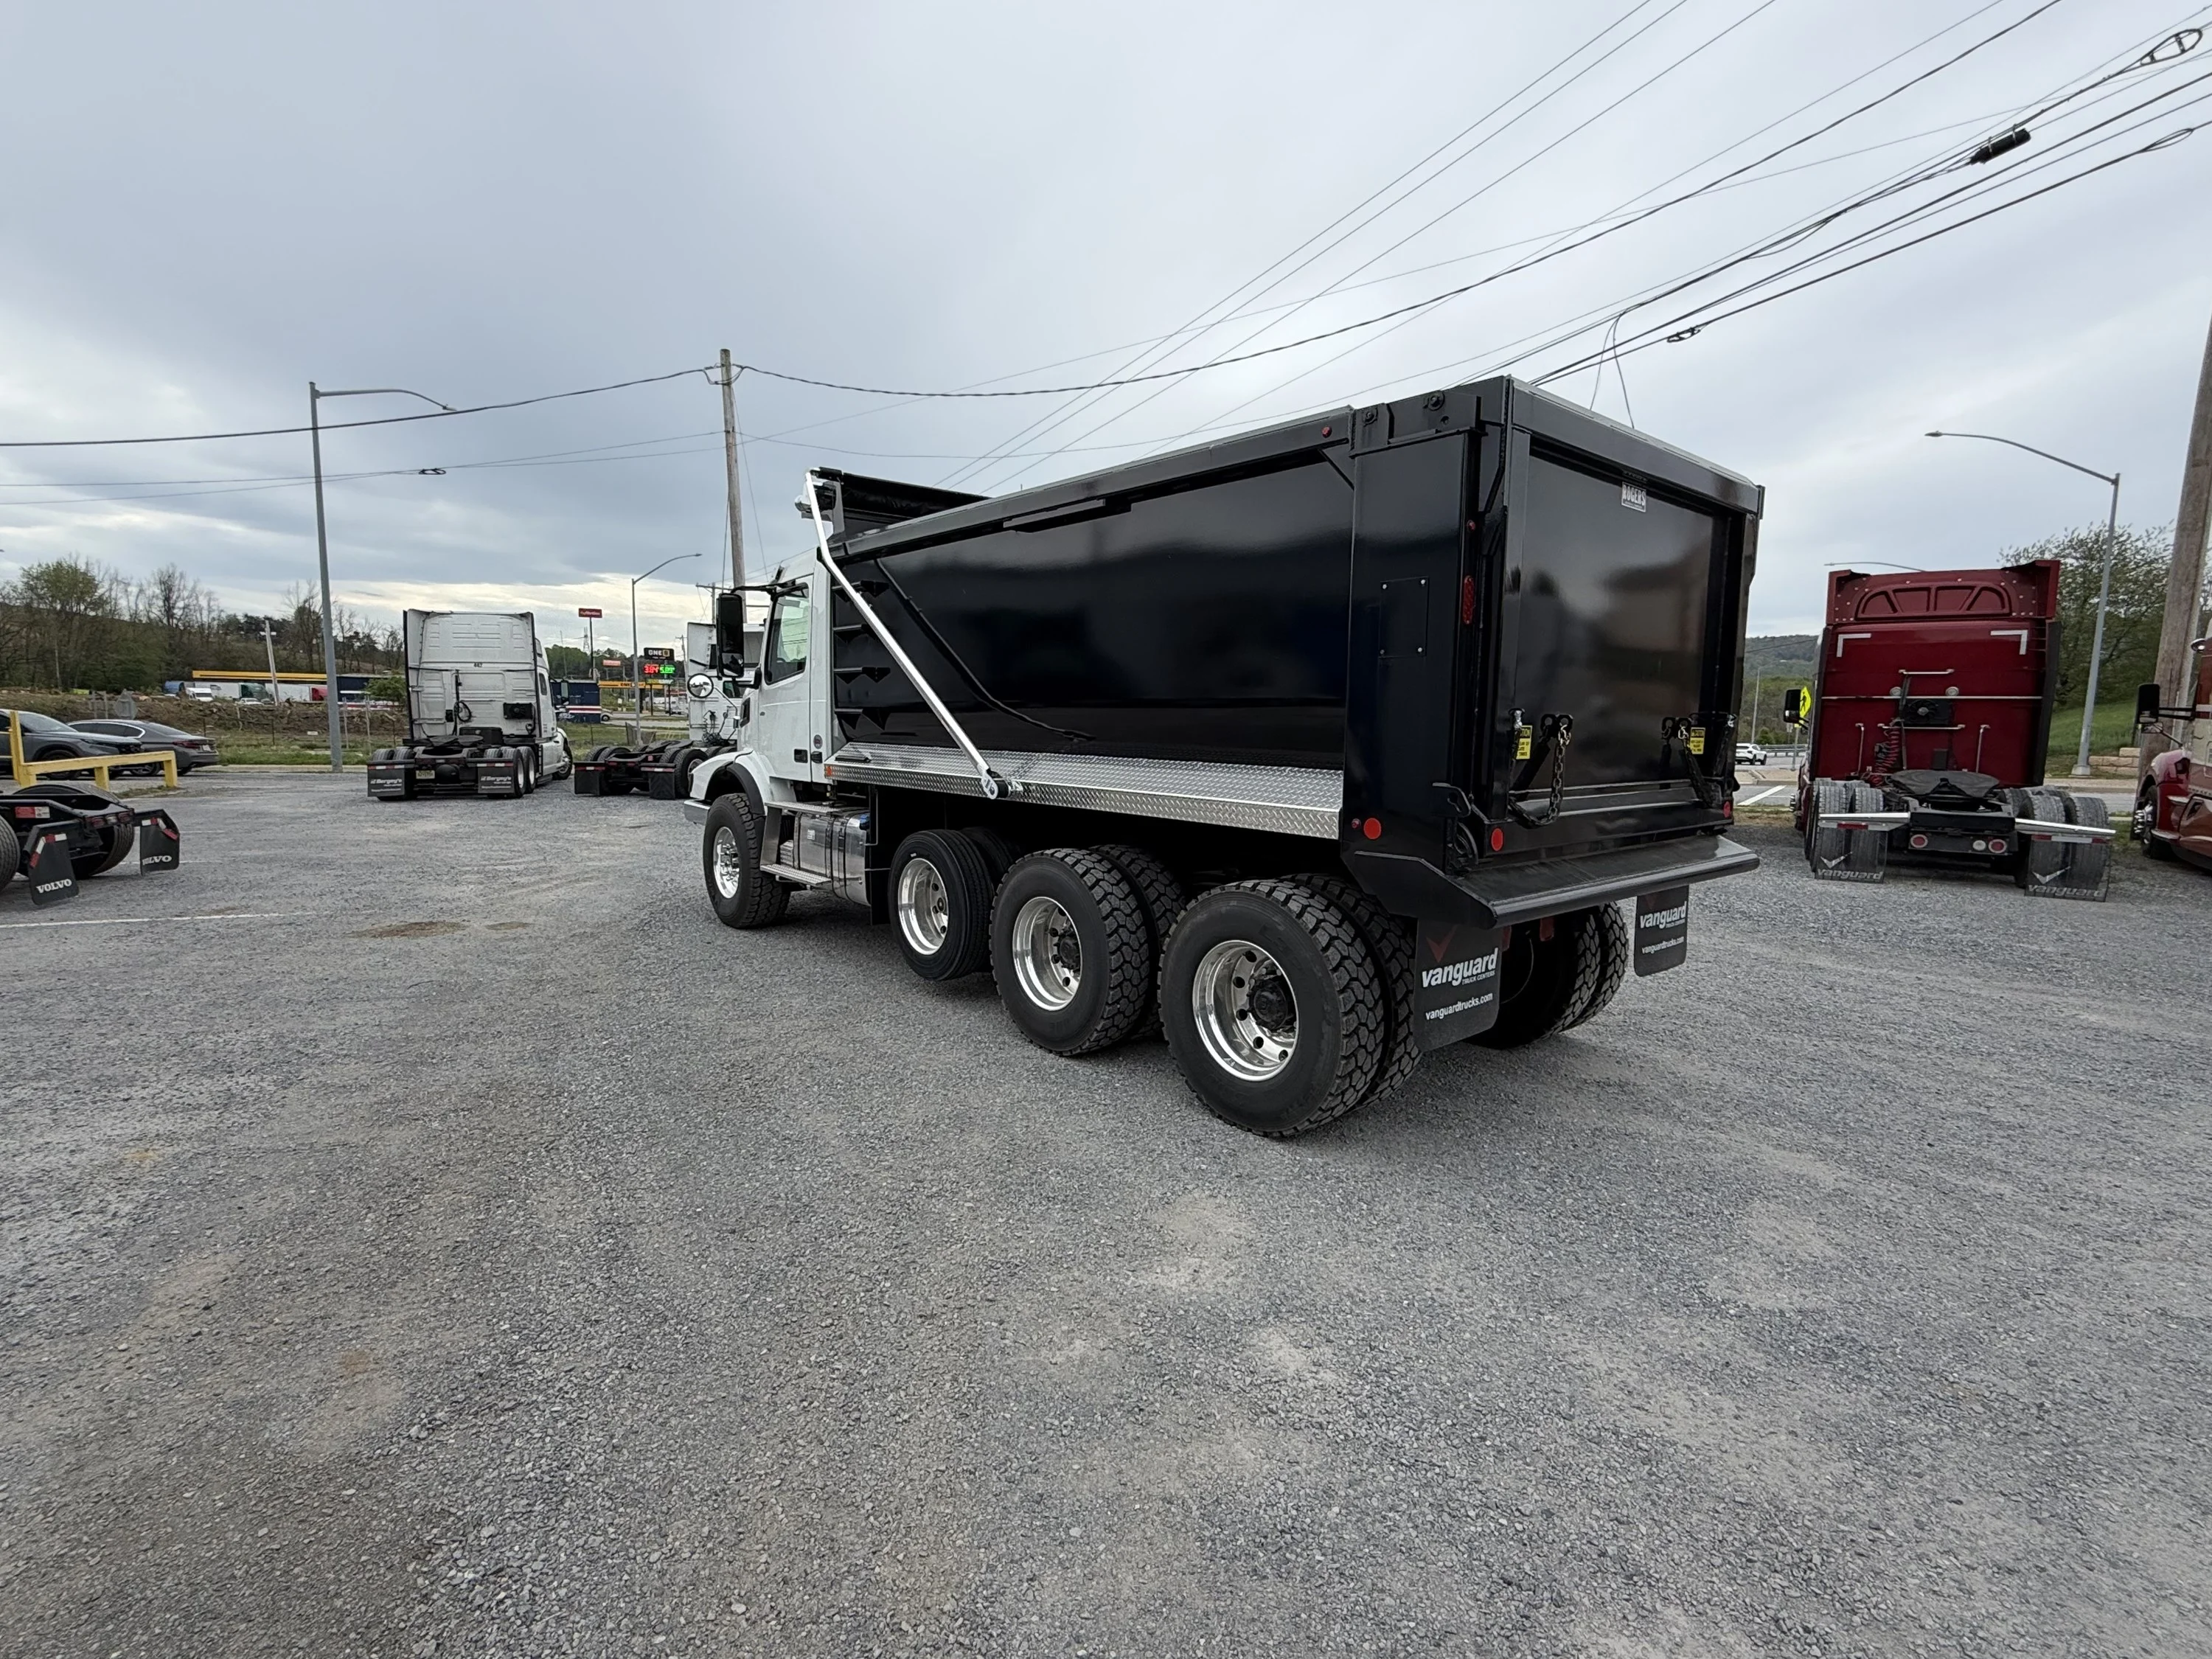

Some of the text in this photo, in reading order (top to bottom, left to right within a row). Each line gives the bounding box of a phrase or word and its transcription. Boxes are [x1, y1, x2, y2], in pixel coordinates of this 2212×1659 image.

[1622, 484, 1646, 506] ROGERS
[1818, 869, 1884, 880] vanguard
[36, 879, 72, 893] VOLVO
[2028, 885, 2107, 897] vanguard
[1640, 900, 1687, 928] vanguard
[1422, 947, 1498, 987] vanguard
[1462, 970, 1495, 985] TRUCK CENTERS
[1425, 992, 1493, 1020] vanguardtrucks.com
